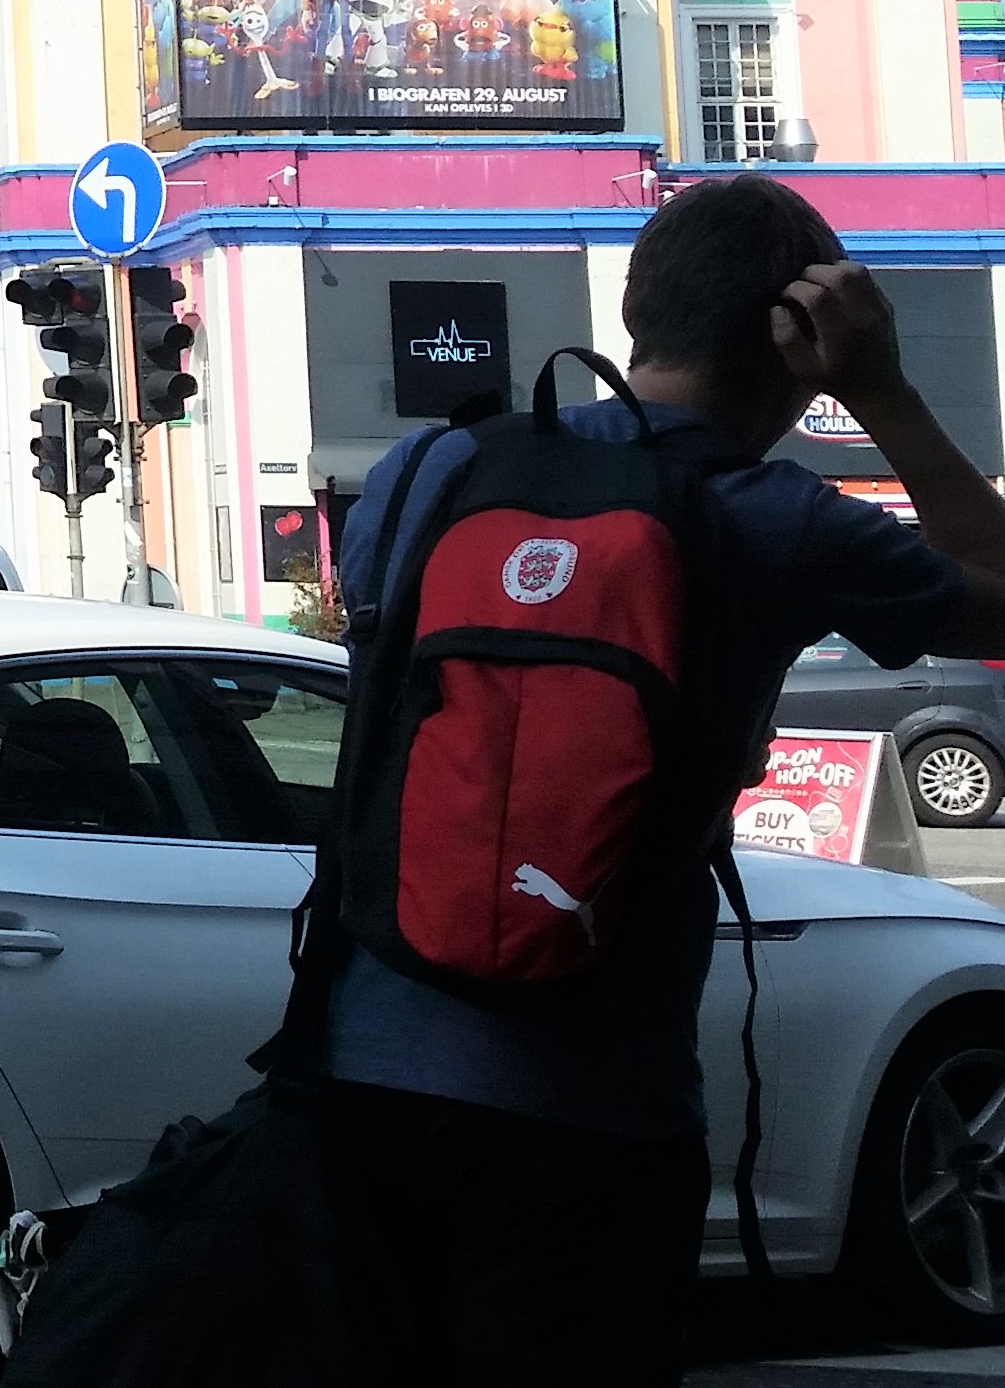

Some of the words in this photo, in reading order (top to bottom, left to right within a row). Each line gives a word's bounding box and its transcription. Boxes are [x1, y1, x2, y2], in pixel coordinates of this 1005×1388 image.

[368, 87, 375, 101] I
[377, 87, 471, 102] BIOGRAFEN
[473, 87, 499, 102] 29.
[502, 88, 567, 102] AUGUST
[424, 103, 449, 113] KAN
[450, 103, 493, 113] OPLEVES
[500, 103, 514, 113] 3D
[427, 347, 477, 362] VENUE
[260, 464, 297, 472] Axeltorv
[765, 747, 823, 770] P-ON
[775, 762, 856, 787] HOP-OFF
[754, 812, 795, 830] BUY
